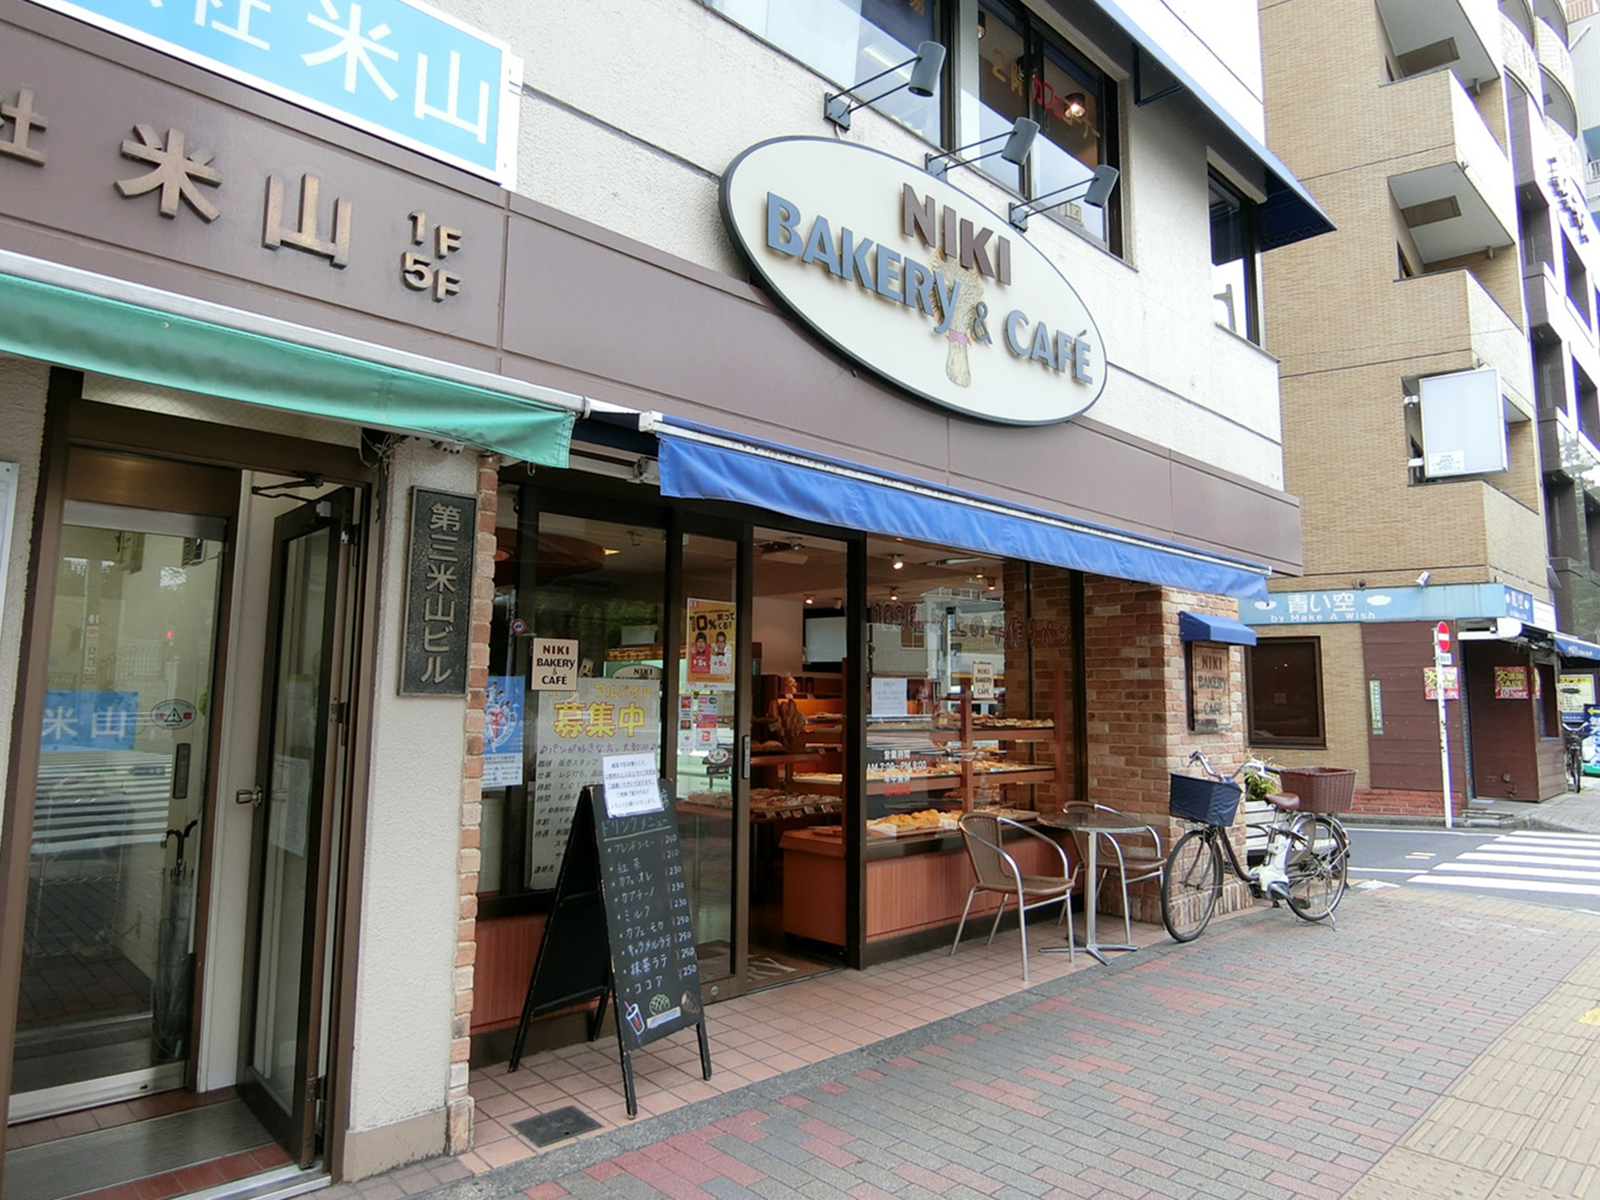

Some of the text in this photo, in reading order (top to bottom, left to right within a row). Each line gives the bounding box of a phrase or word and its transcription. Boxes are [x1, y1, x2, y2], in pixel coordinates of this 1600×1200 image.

[407, 210, 463, 259] 1F
[903, 182, 1012, 287] NIKI
[400, 249, 464, 303] 5F
[972, 301, 993, 346] &
[1004, 309, 1093, 385] CAFÉ
[418, 502, 463, 686] 第三米山ビル
[1288, 591, 1356, 614] 青い空
[690, 614, 718, 632] 10%
[1270, 610, 1376, 623] by Make A Wish
[542, 645, 570, 656] NIKI
[1202, 654, 1222, 670] NIKI
[633, 668, 653, 676] NIKI
[42, 705, 127, 740] 米山
[554, 701, 646, 738] 募集中
[601, 816, 668, 838] ドリンクメニュー
[623, 905, 651, 923] ミルク
[630, 953, 668, 978] 抹茶ラテ
[633, 974, 664, 995] ココア
